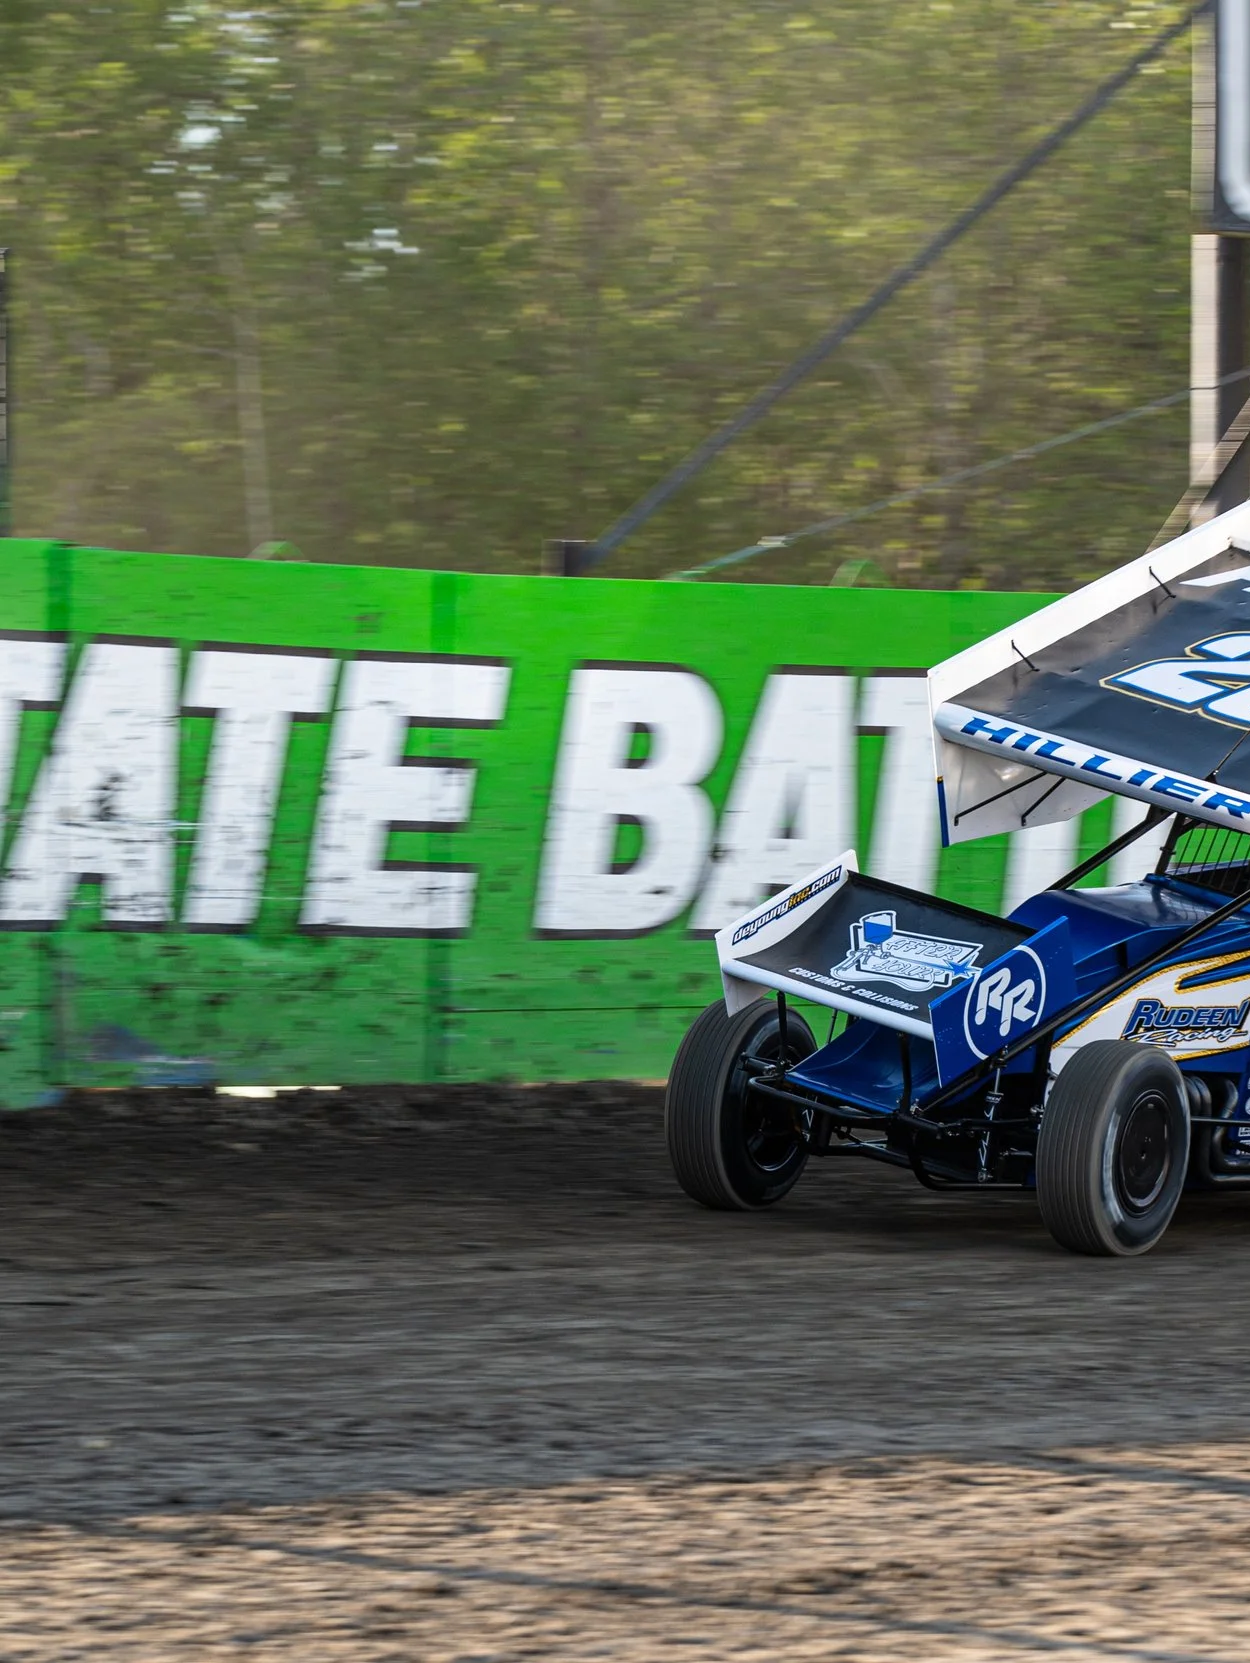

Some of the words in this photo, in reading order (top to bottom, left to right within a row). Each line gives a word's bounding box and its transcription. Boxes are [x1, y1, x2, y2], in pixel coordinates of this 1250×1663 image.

[733, 866, 841, 944] deyounginc.com
[885, 937, 962, 960] AFTER
[788, 966, 842, 988] CUSTOMS
[852, 986, 919, 1011] COLLISIONS
[1129, 1025, 1248, 1048] Racing
